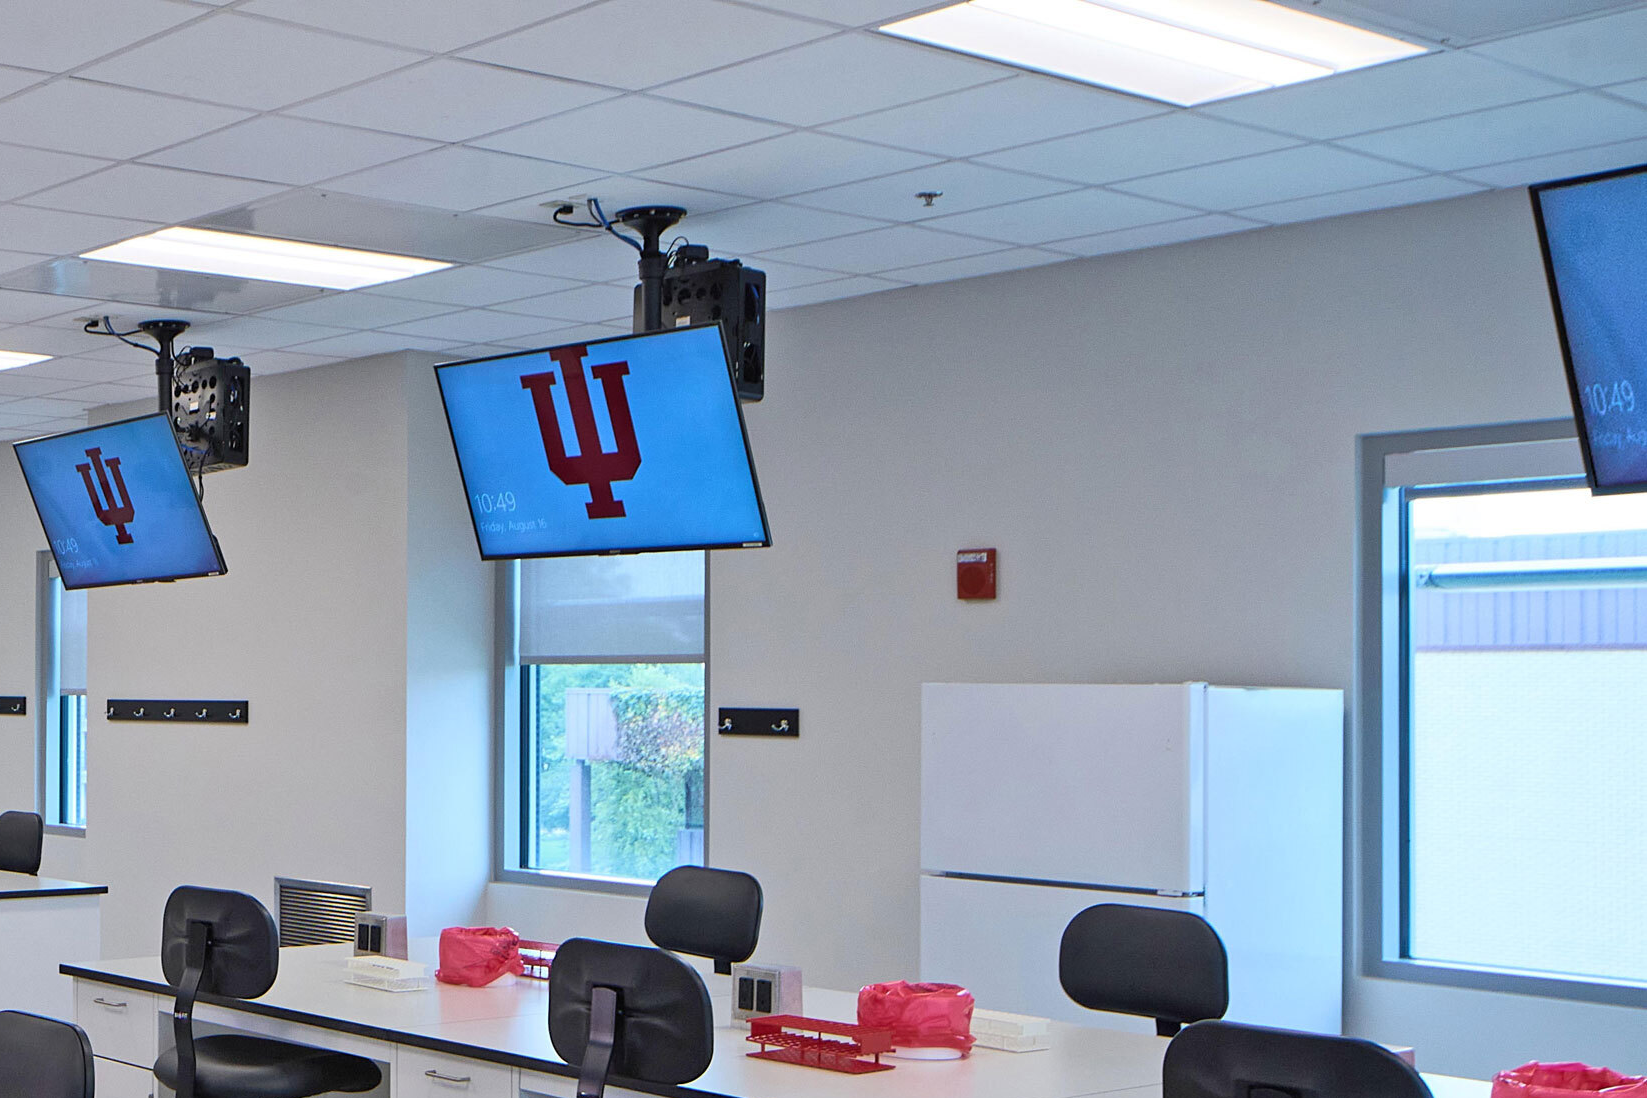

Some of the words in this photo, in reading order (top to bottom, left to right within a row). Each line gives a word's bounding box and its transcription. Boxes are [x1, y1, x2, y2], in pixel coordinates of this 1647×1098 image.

[1584, 380, 1635, 415] 10:49
[474, 491, 516, 514] 10:49
[508, 519, 537, 533] August
